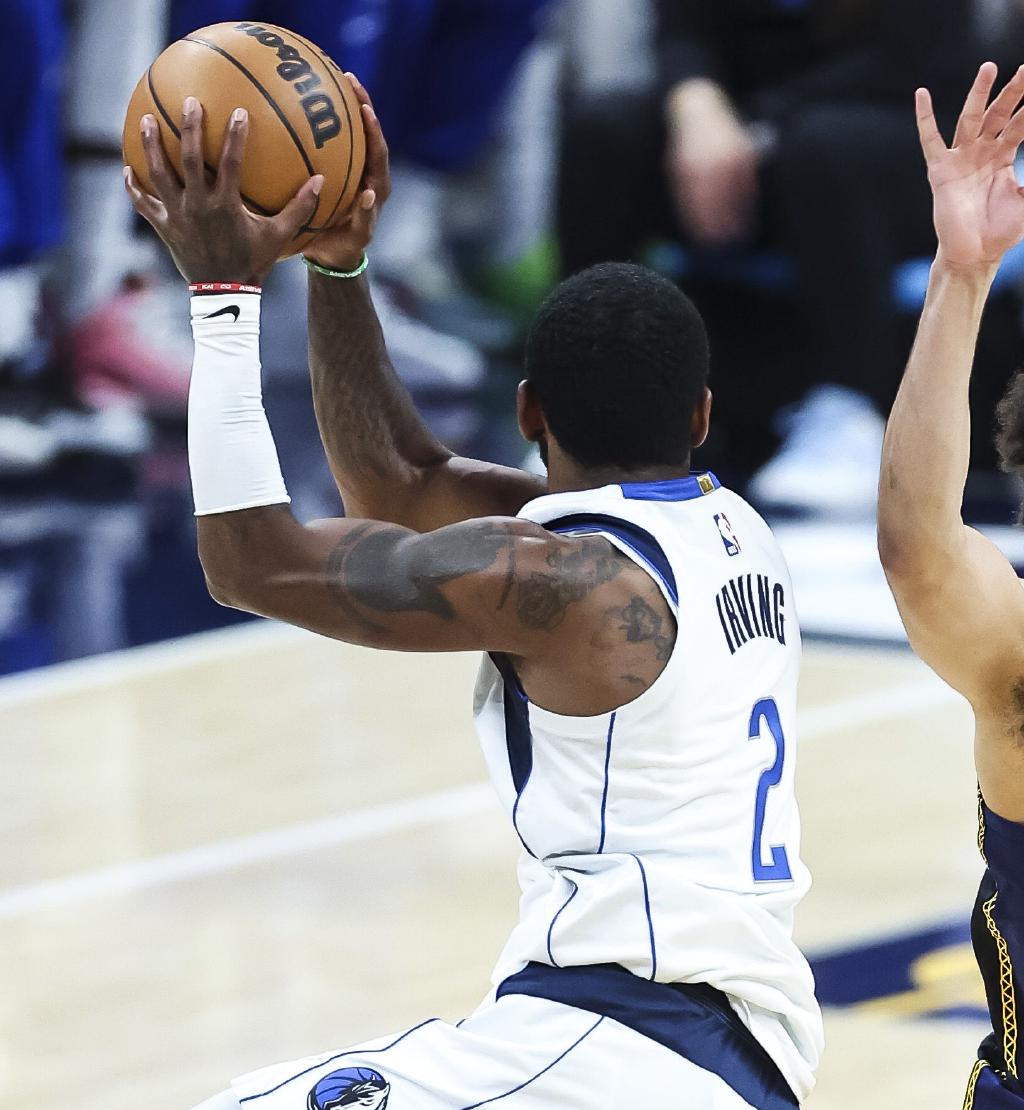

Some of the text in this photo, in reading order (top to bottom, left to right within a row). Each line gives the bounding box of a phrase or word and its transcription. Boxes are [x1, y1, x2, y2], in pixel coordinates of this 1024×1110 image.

[234, 23, 342, 149] Wilson
[716, 573, 786, 655] IRVING
[748, 696, 794, 884] 2
